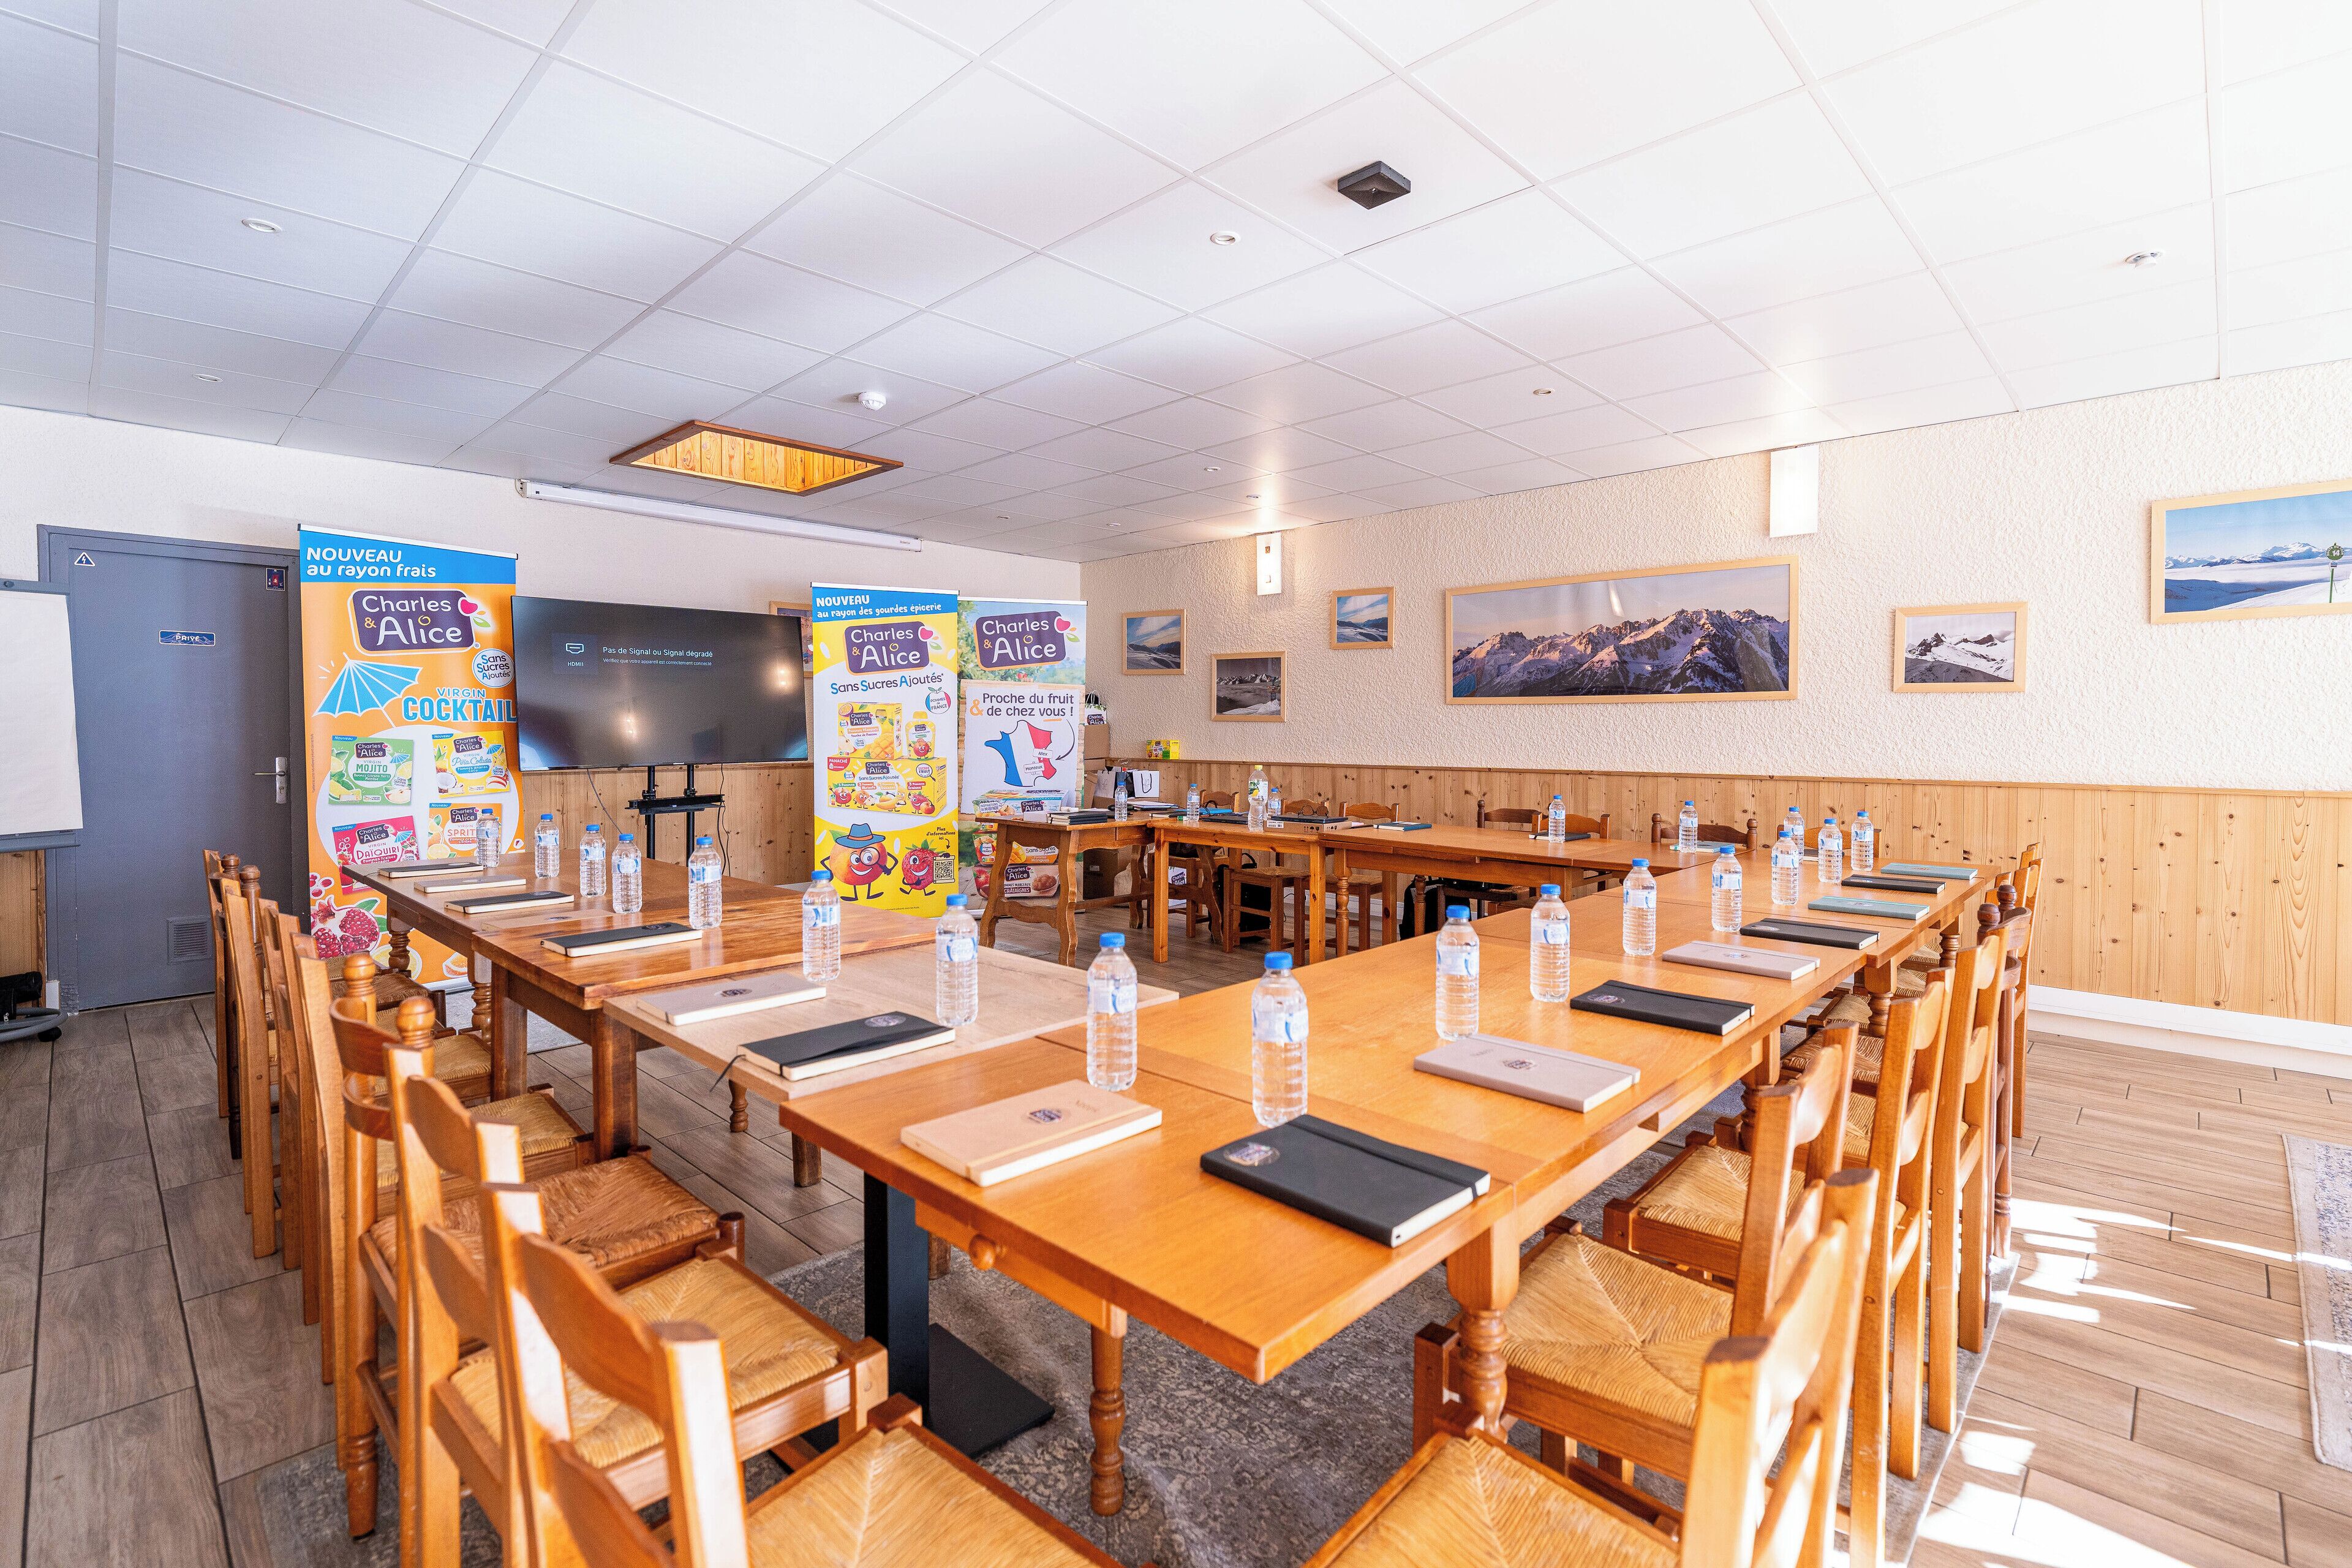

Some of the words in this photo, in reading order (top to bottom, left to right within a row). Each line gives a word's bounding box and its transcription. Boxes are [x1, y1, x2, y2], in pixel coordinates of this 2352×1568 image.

[306, 547, 402, 563] NOUVEAU
[306, 564, 331, 576] au
[337, 564, 391, 579] rayon
[396, 564, 436, 578] frais
[362, 595, 452, 613] Charles
[816, 595, 870, 607] NOUVEAU
[831, 608, 856, 619] rayon
[859, 606, 873, 616] des
[875, 605, 908, 616] gourdes
[910, 603, 941, 614] épicerie
[364, 617, 376, 628] &
[377, 615, 462, 646] Alice
[982, 619, 1049, 635] Charles
[851, 628, 914, 643] Charles
[629, 647, 650, 656] Signal
[983, 639, 992, 649] &
[992, 635, 1057, 663] Alice
[481, 654, 507, 664] Sans
[852, 647, 861, 655] &
[860, 643, 921, 669] Alice
[477, 662, 510, 673] Sucres
[436, 687, 486, 698] VIRGIN
[831, 682, 859, 695] Sans
[861, 678, 899, 692] Sucres
[982, 693, 1025, 704] Proche
[1030, 693, 1044, 704] du
[1047, 693, 1074, 704] fruit
[402, 697, 517, 722] COCKTAIL
[970, 699, 984, 716] &
[987, 706, 1002, 716] de
[1006, 706, 1035, 716] chez
[1039, 707, 1066, 717] vous
[360, 748, 383, 757] Alice
[459, 742, 480, 752] Alice
[356, 764, 388, 772] MOJITO
[454, 813, 475, 822] Alice
[358, 826, 382, 835] Charles
[363, 832, 386, 843] Alice
[356, 846, 399, 860] DAÏQUIRI
[1009, 872, 1028, 880] Alice
